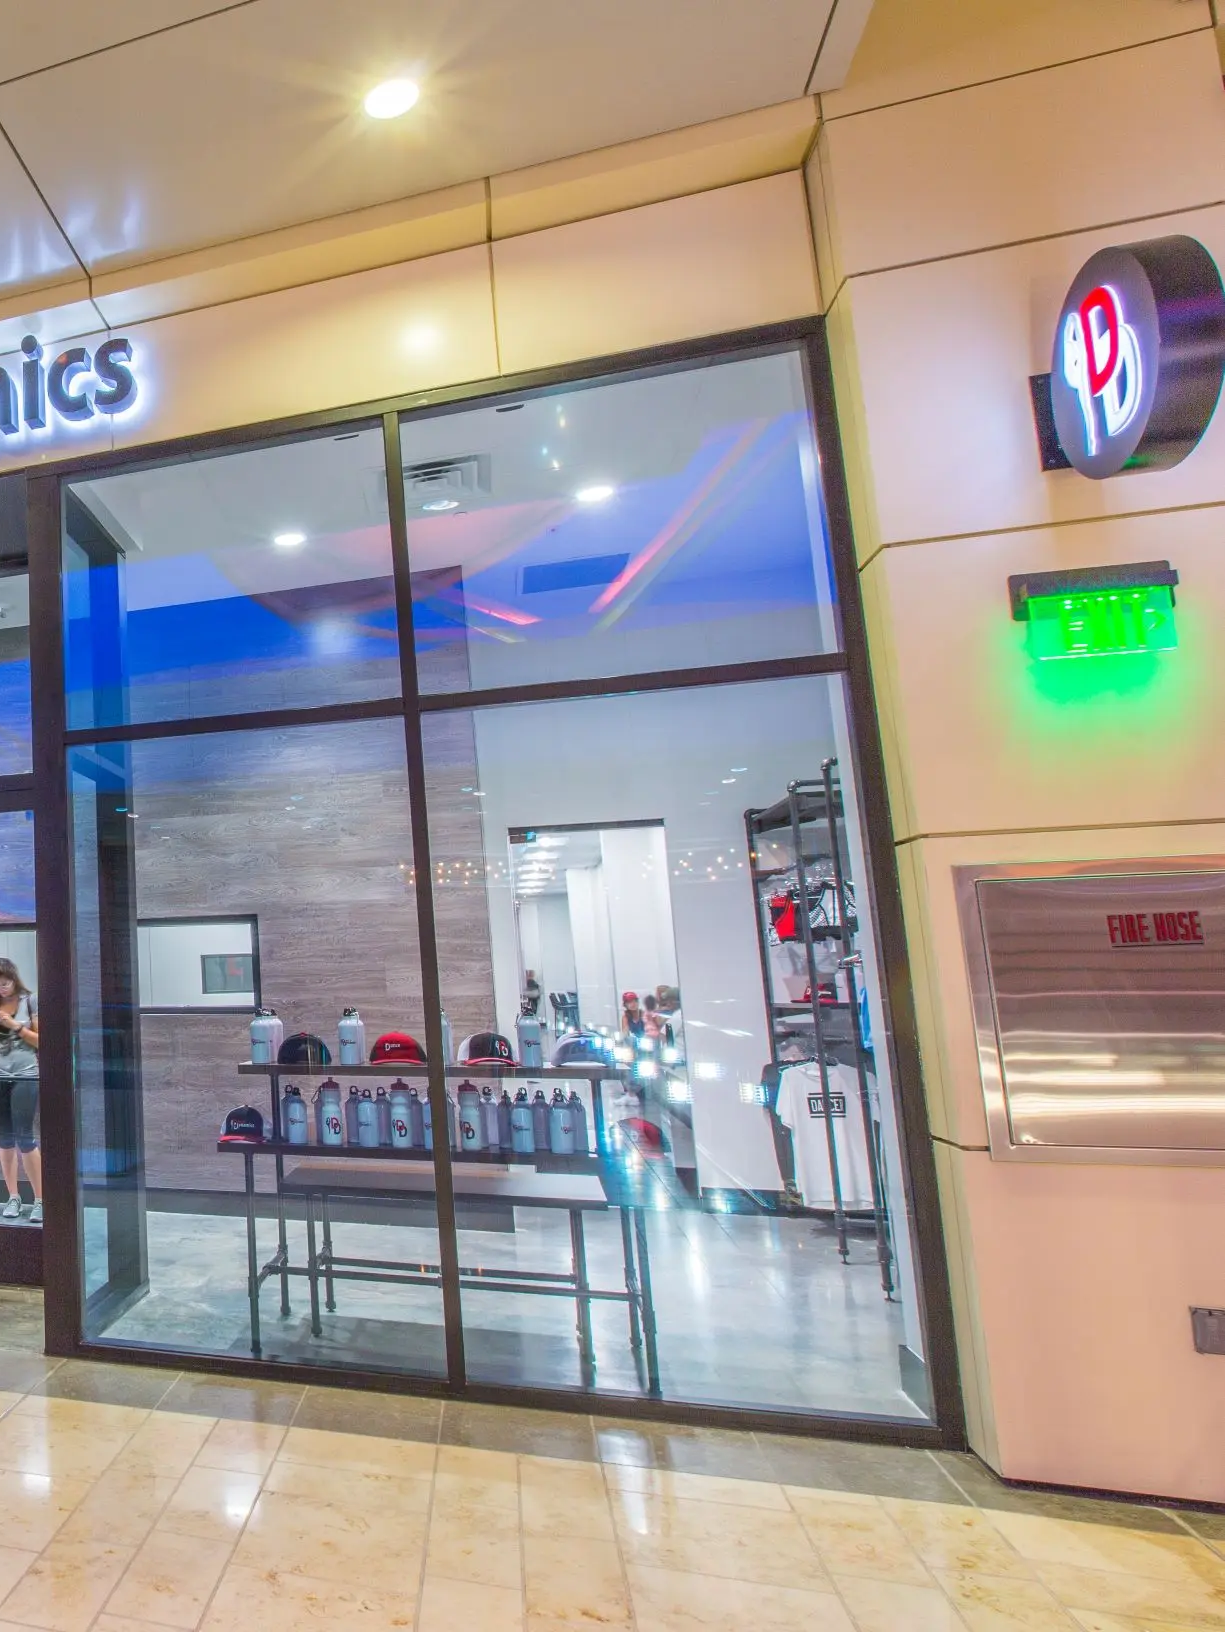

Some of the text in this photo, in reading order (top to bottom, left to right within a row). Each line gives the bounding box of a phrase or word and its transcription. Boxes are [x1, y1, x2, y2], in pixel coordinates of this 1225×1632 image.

[1058, 594, 1148, 653] EXIT
[1106, 910, 1204, 944] FIRE HOSE
[810, 1098, 844, 1112] DACER
